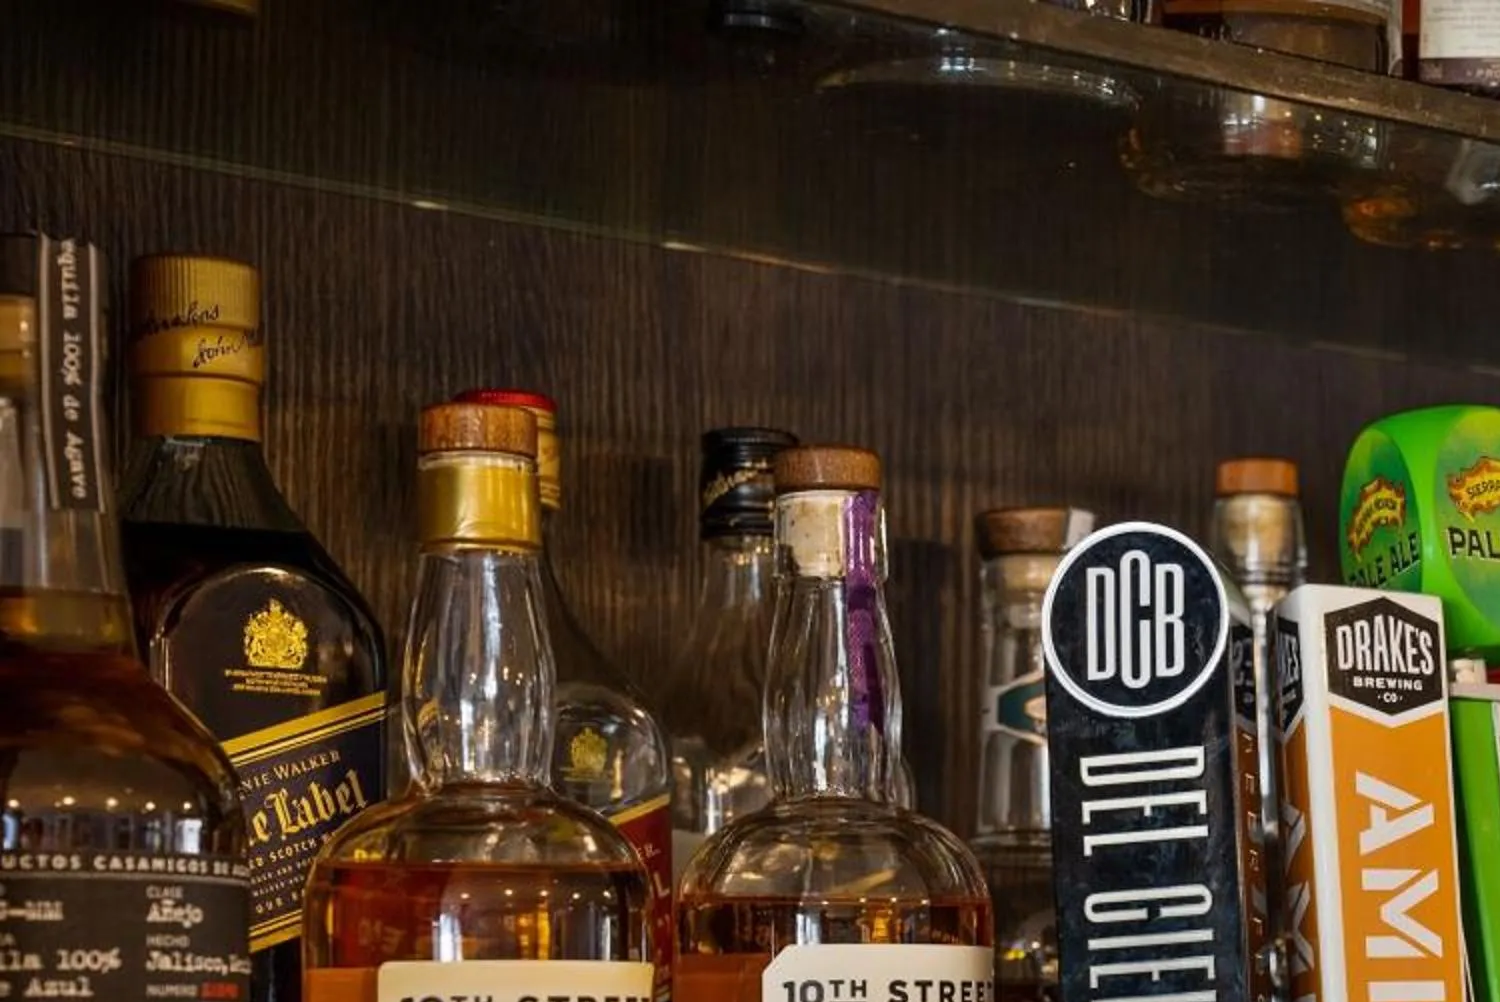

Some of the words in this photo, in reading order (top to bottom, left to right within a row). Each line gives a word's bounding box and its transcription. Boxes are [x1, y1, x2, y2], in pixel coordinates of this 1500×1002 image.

[64, 432, 86, 499] Agave
[1390, 531, 1420, 575] ALE
[1086, 549, 1185, 689] DCB
[1336, 614, 1434, 675] DRAKE'S
[1353, 676, 1423, 691] BREWING
[273, 750, 341, 779] WALKER
[264, 768, 366, 840] Label
[1079, 745, 1209, 857] DEL
[94, 855, 208, 875] CASAMIGOS
[24, 976, 94, 998] Azul
